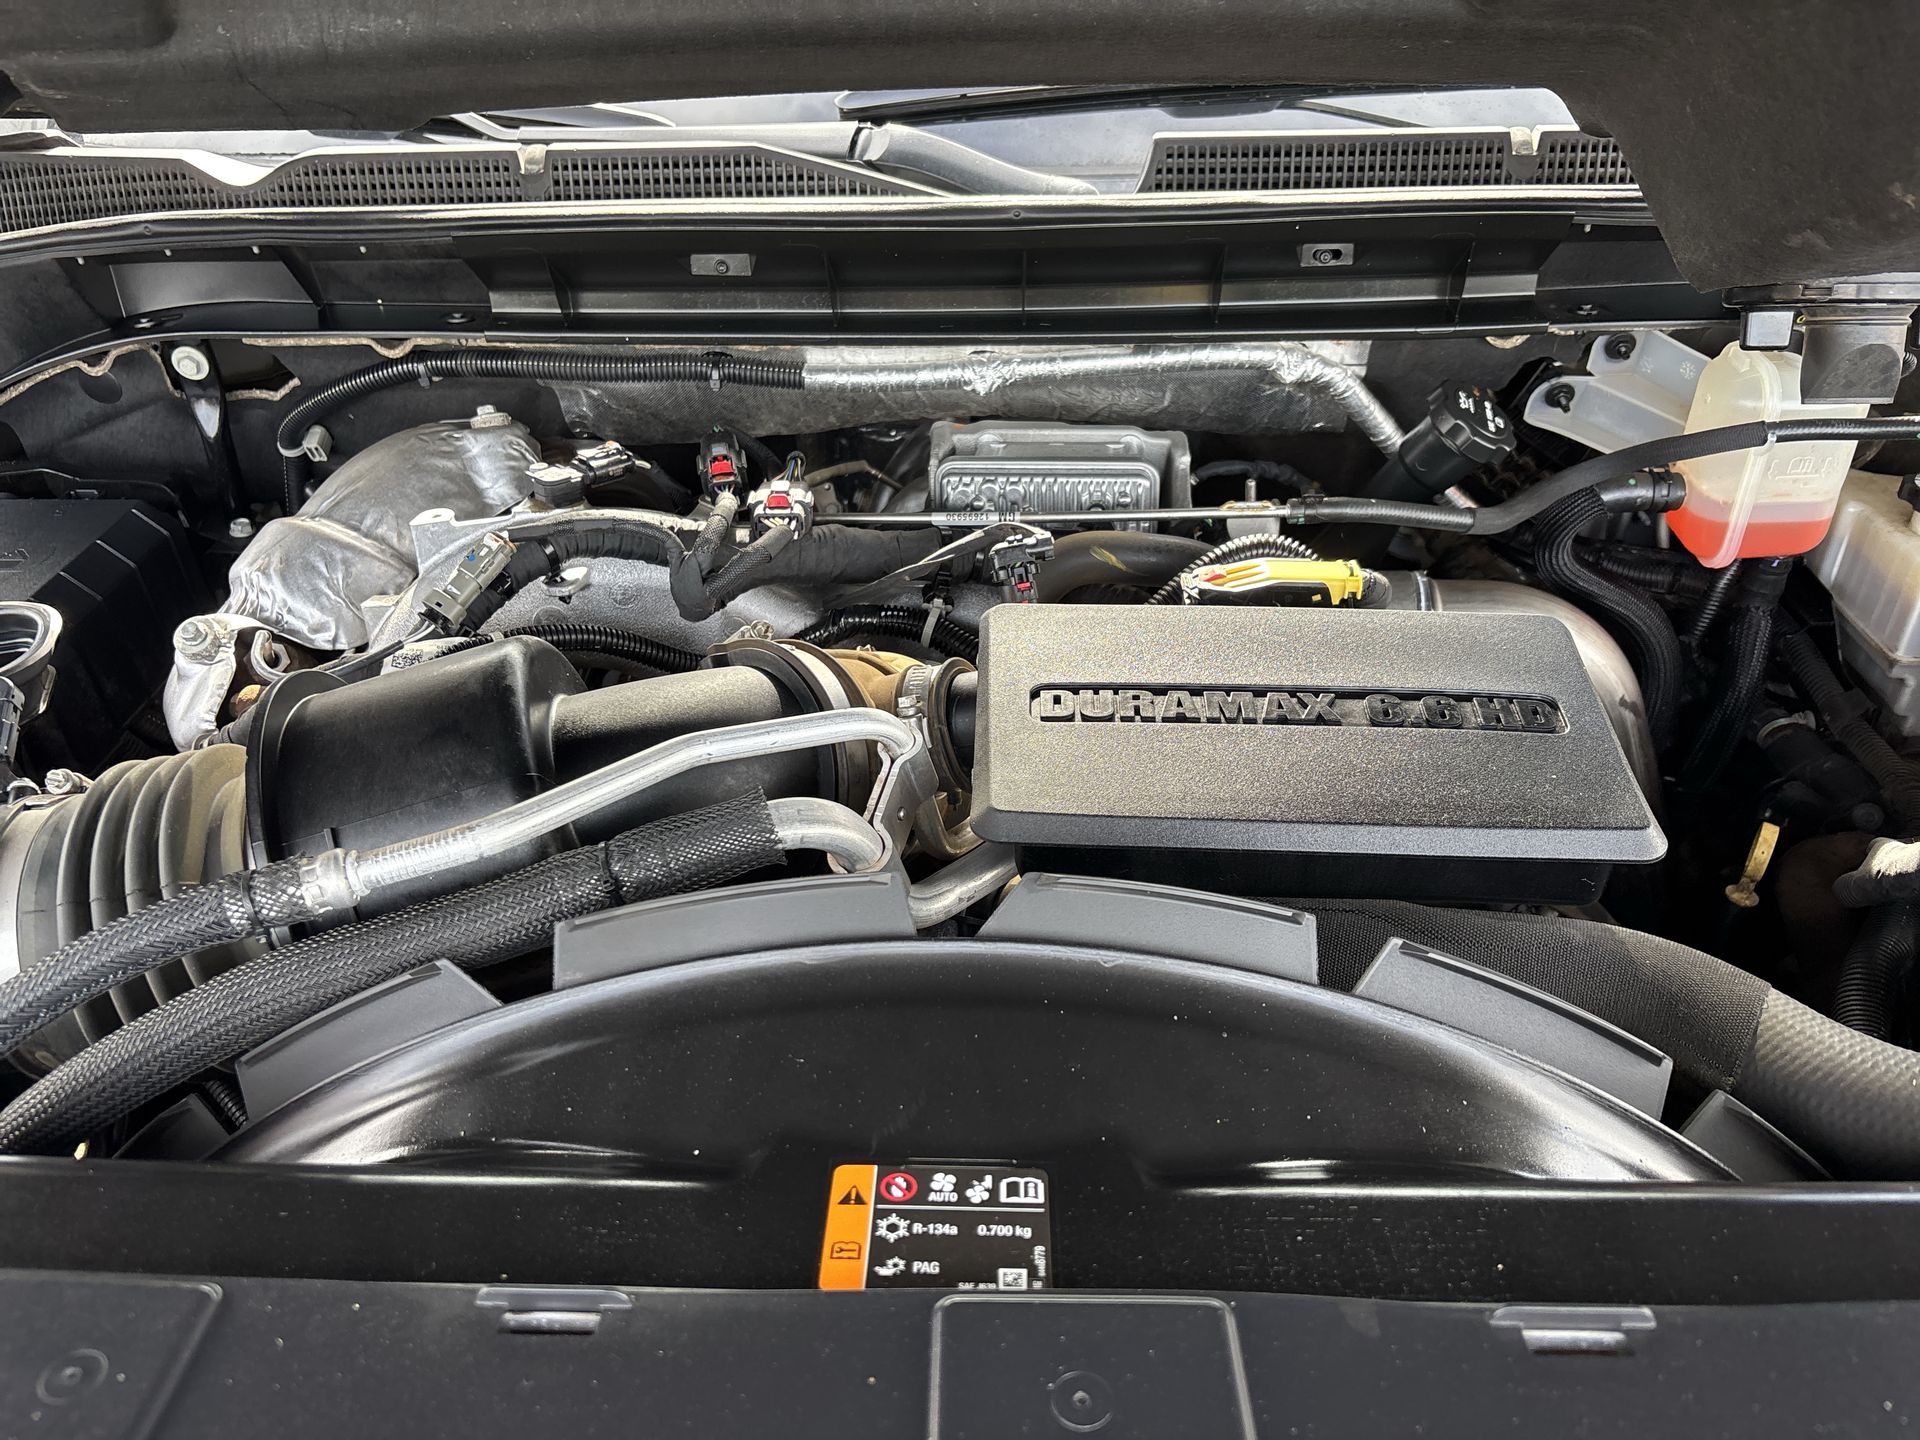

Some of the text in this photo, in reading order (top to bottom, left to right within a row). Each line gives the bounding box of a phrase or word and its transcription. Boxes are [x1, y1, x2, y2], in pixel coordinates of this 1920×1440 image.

[998, 512, 1015, 522] GM
[1039, 689, 1559, 733] DURAMAX 6.6 HD
[928, 1191, 958, 1203] AUTO
[912, 1223, 1032, 1239] R-134a 0.700 kg
[912, 1261, 940, 1274] PAG
